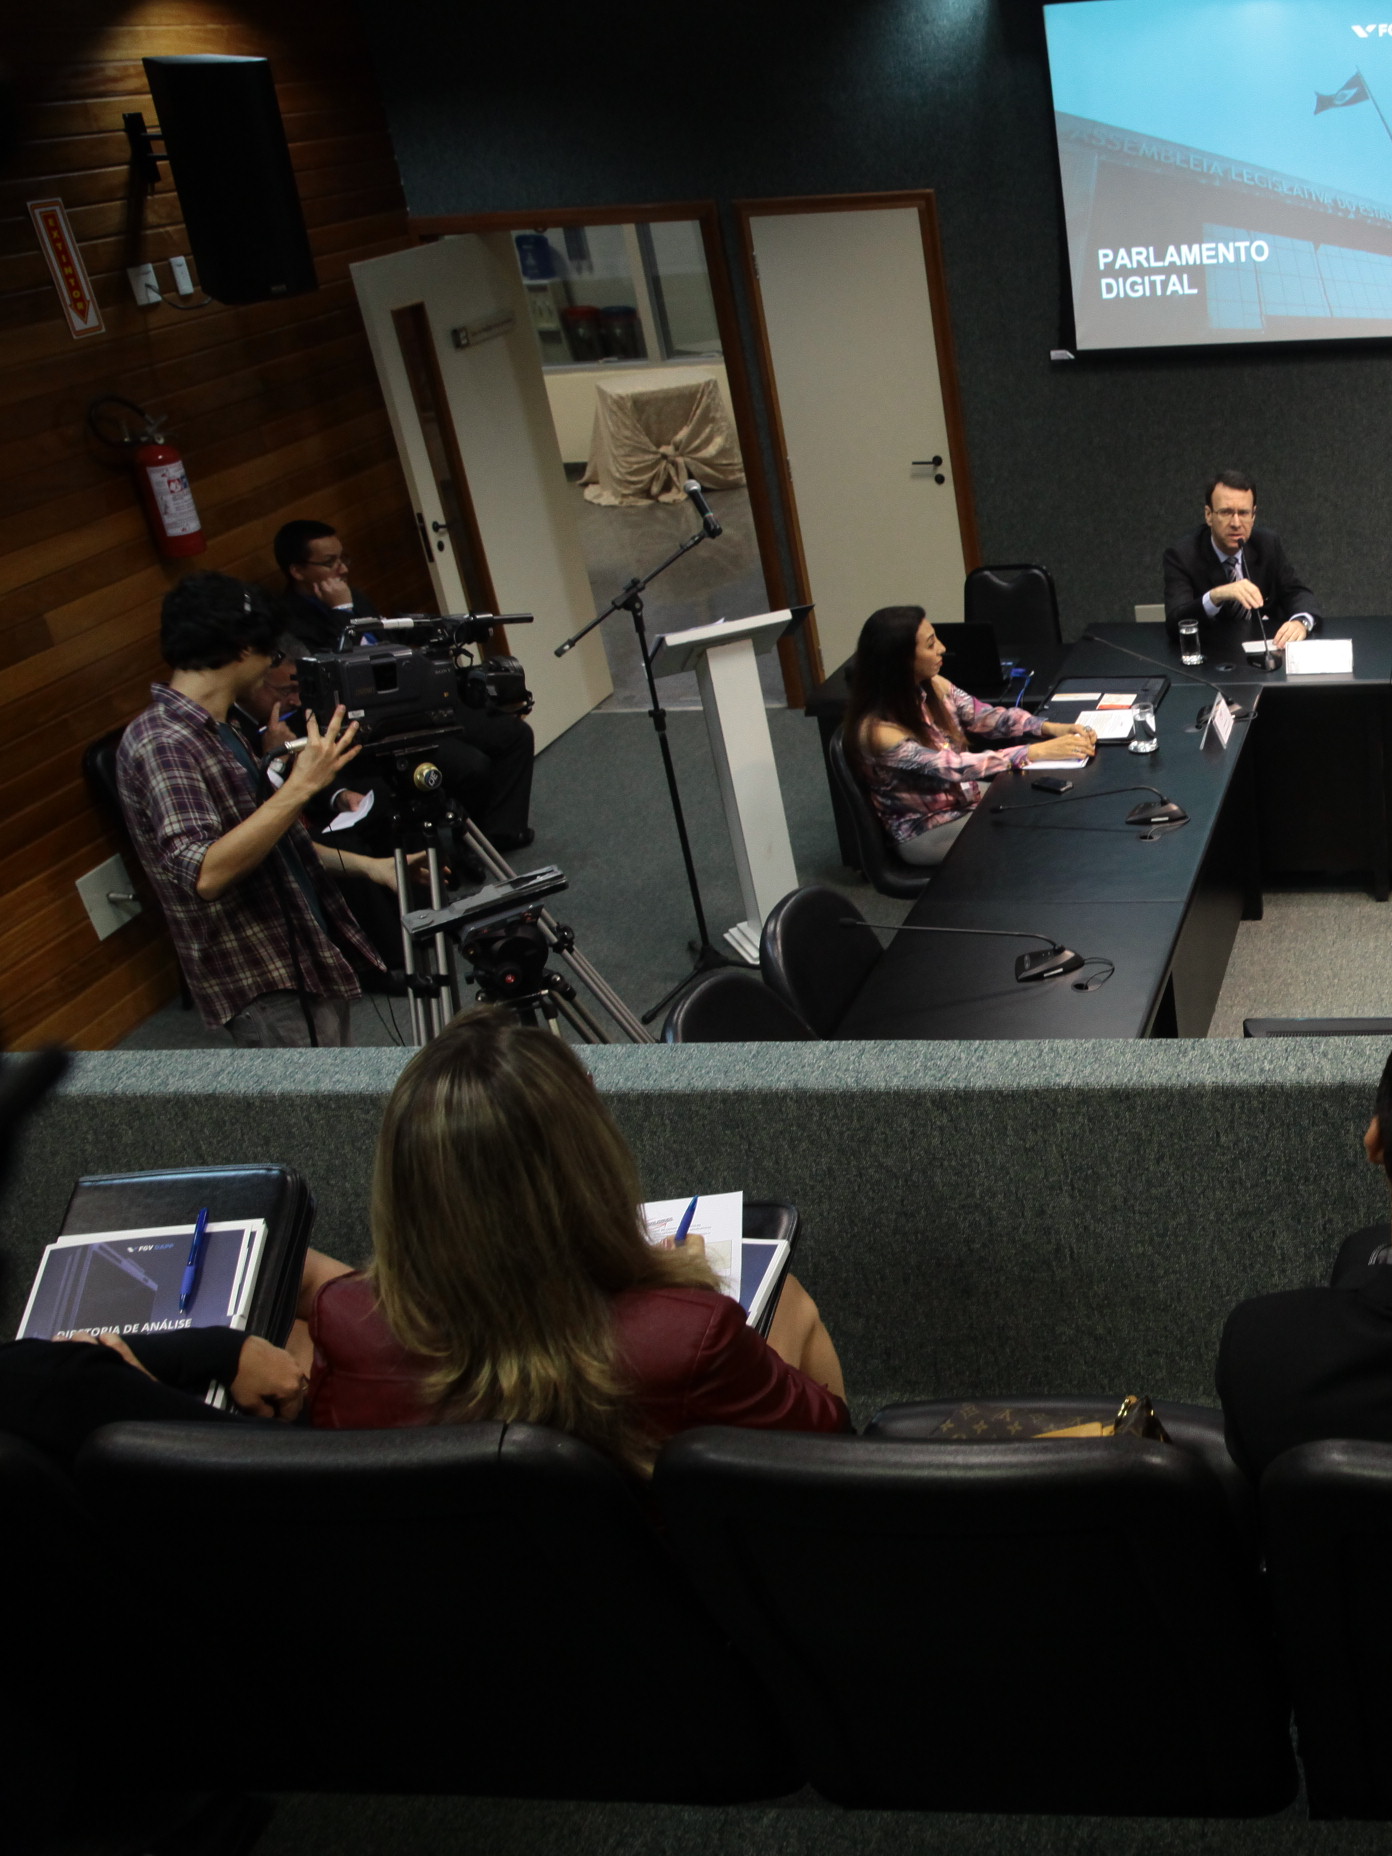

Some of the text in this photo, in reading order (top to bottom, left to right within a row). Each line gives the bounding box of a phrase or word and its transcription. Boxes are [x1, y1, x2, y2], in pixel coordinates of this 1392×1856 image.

[1069, 127, 1223, 176] ASSEMBLEIA
[1231, 164, 1333, 206] LEGISLATIVA
[48, 218, 84, 310] EXTINTOR
[1098, 240, 1270, 271] PARLAMENTO
[1101, 273, 1198, 299] DIGITAL
[123, 1323, 140, 1334] DE
[141, 1318, 192, 1334] ANÁLISE
